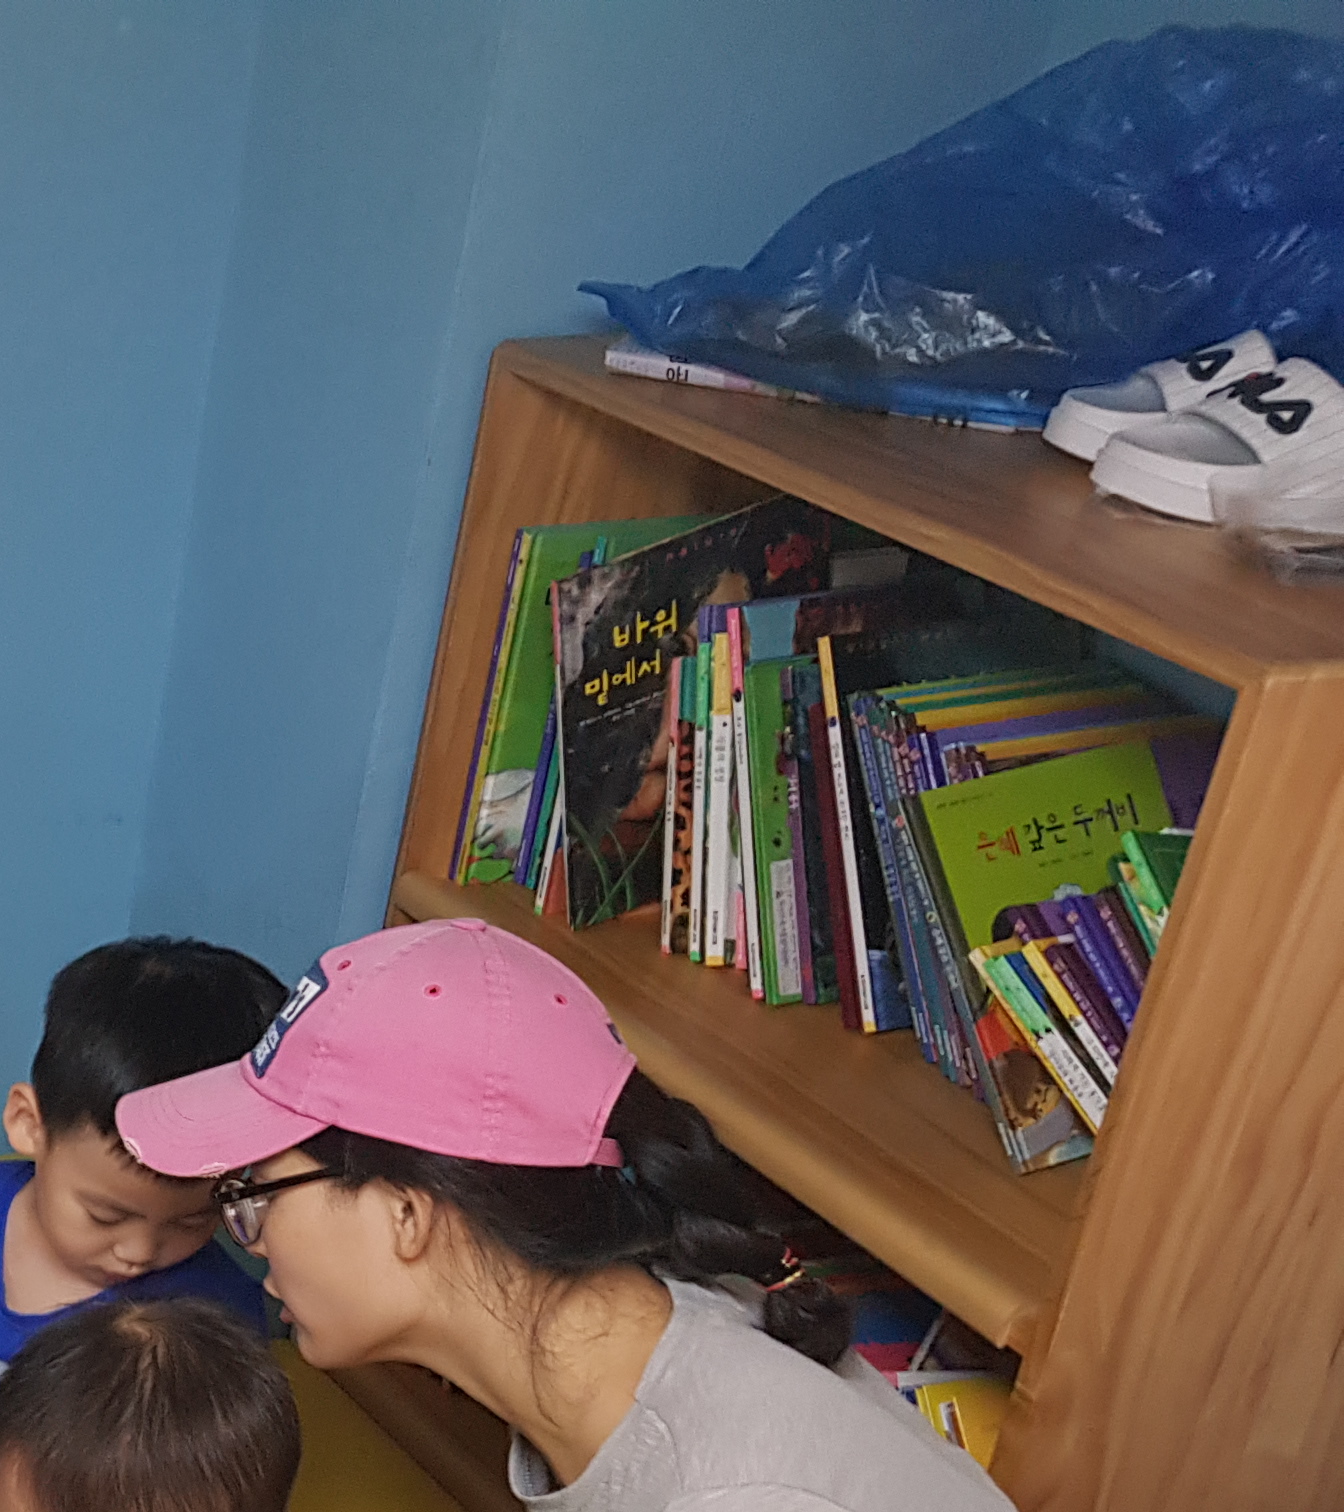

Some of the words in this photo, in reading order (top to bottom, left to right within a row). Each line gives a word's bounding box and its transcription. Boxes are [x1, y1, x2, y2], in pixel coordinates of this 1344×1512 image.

[613, 599, 679, 648] 바위
[584, 648, 662, 706] 밑에서
[1073, 793, 1140, 838] 두꺼비
